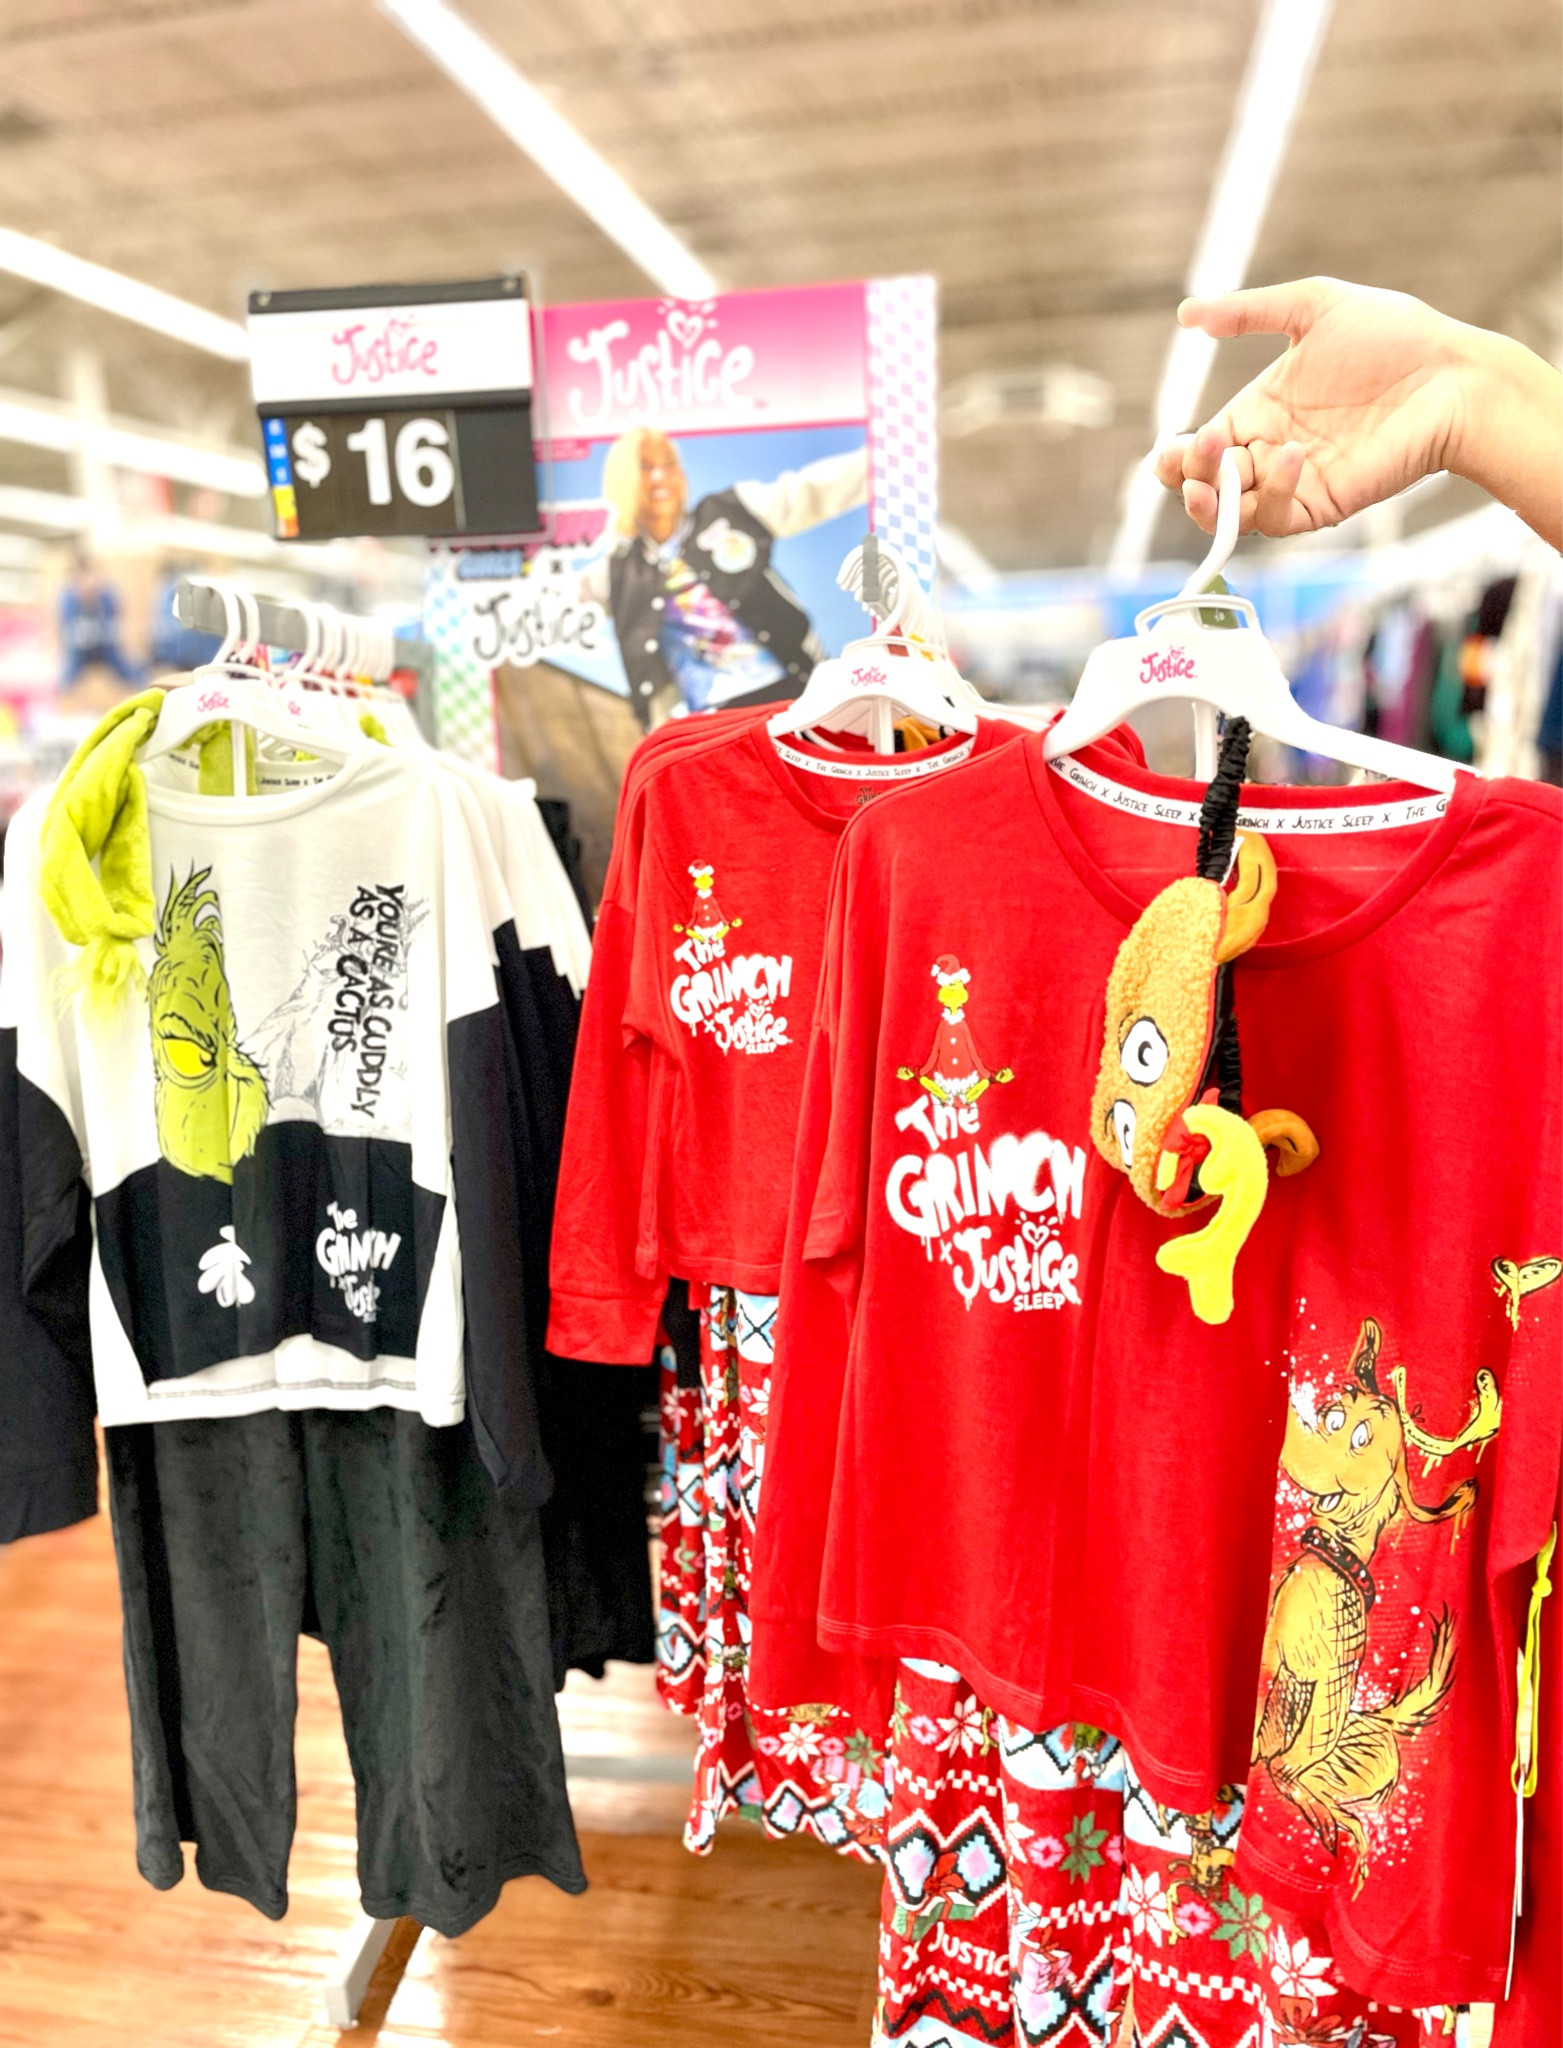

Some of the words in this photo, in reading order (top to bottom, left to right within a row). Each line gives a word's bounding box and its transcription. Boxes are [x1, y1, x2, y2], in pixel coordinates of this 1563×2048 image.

[332, 317, 438, 385] Justice
[566, 308, 756, 430] Justice
[347, 417, 455, 507] 16
[473, 585, 596, 661] Justice
[851, 666, 887, 686] Justice
[1139, 646, 1196, 684] Justice
[349, 885, 381, 919] AS
[347, 927, 374, 944] A
[673, 937, 726, 972] The
[327, 954, 368, 1053] CACTUS
[366, 976, 394, 1009] AS
[669, 953, 793, 1030] GRINCH
[713, 1000, 790, 1053] Justice
[350, 1015, 393, 1119] CUDDLY
[894, 1092, 981, 1151] The
[885, 1131, 1087, 1245] GRINCH
[952, 1215, 1082, 1308] Justice
[1013, 1291, 1066, 1313] SLEEP
[927, 1921, 1011, 1977] JUSTIC
